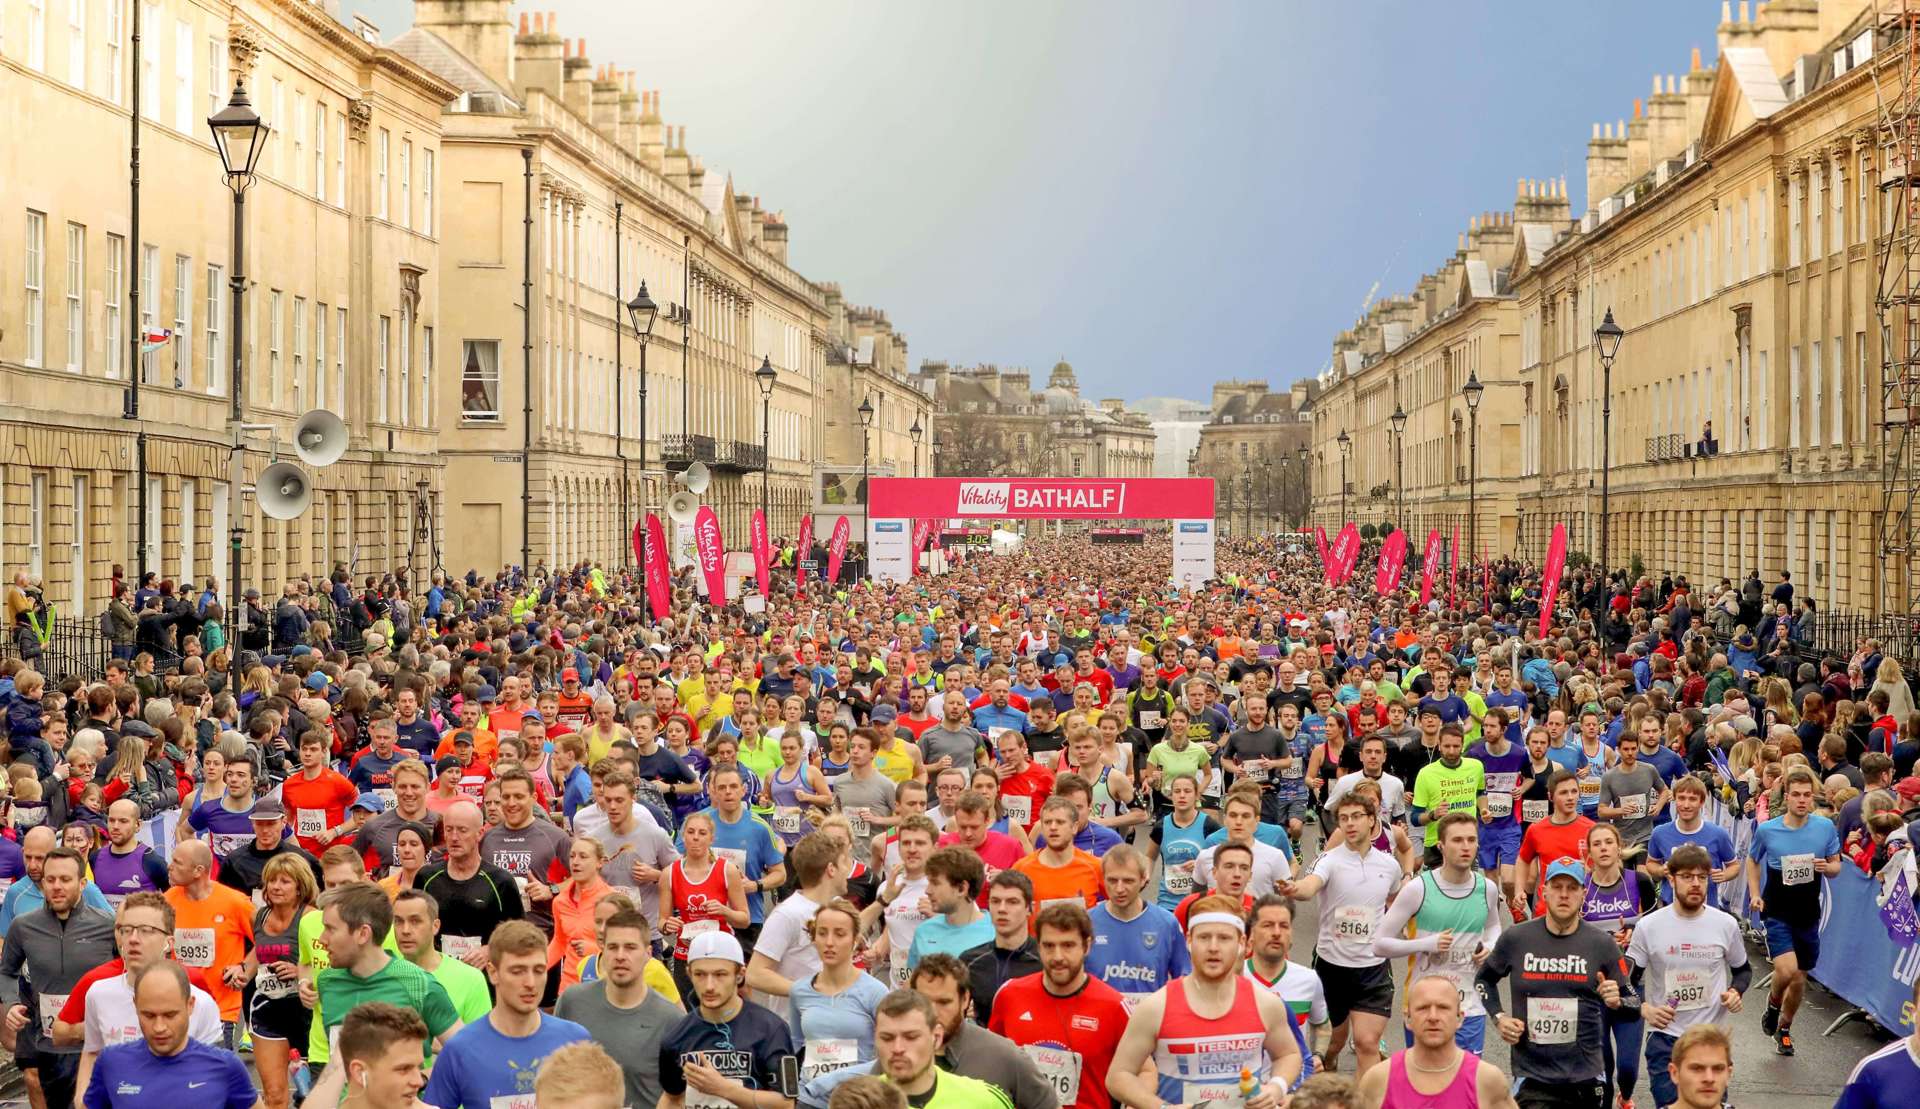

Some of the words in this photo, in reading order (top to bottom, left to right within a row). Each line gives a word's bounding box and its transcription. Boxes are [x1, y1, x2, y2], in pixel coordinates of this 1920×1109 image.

[962, 485, 1007, 511] Vitality
[1015, 489, 1114, 508] BATHALF
[703, 518, 717, 572] Vitality
[301, 821, 322, 832] 2309
[493, 853, 532, 863] LEWIS
[1787, 867, 1810, 880] 2350
[1587, 897, 1632, 914] Stroke
[1340, 921, 1369, 936] 5164
[180, 945, 209, 959] 5935
[1523, 952, 1588, 974] CrossFit
[1103, 960, 1156, 983] jobsite
[1672, 986, 1704, 1001] 3897
[1534, 1020, 1569, 1034] 4978
[1199, 1039, 1260, 1053] TEENAGE
[1200, 1063, 1241, 1075] TRUST
